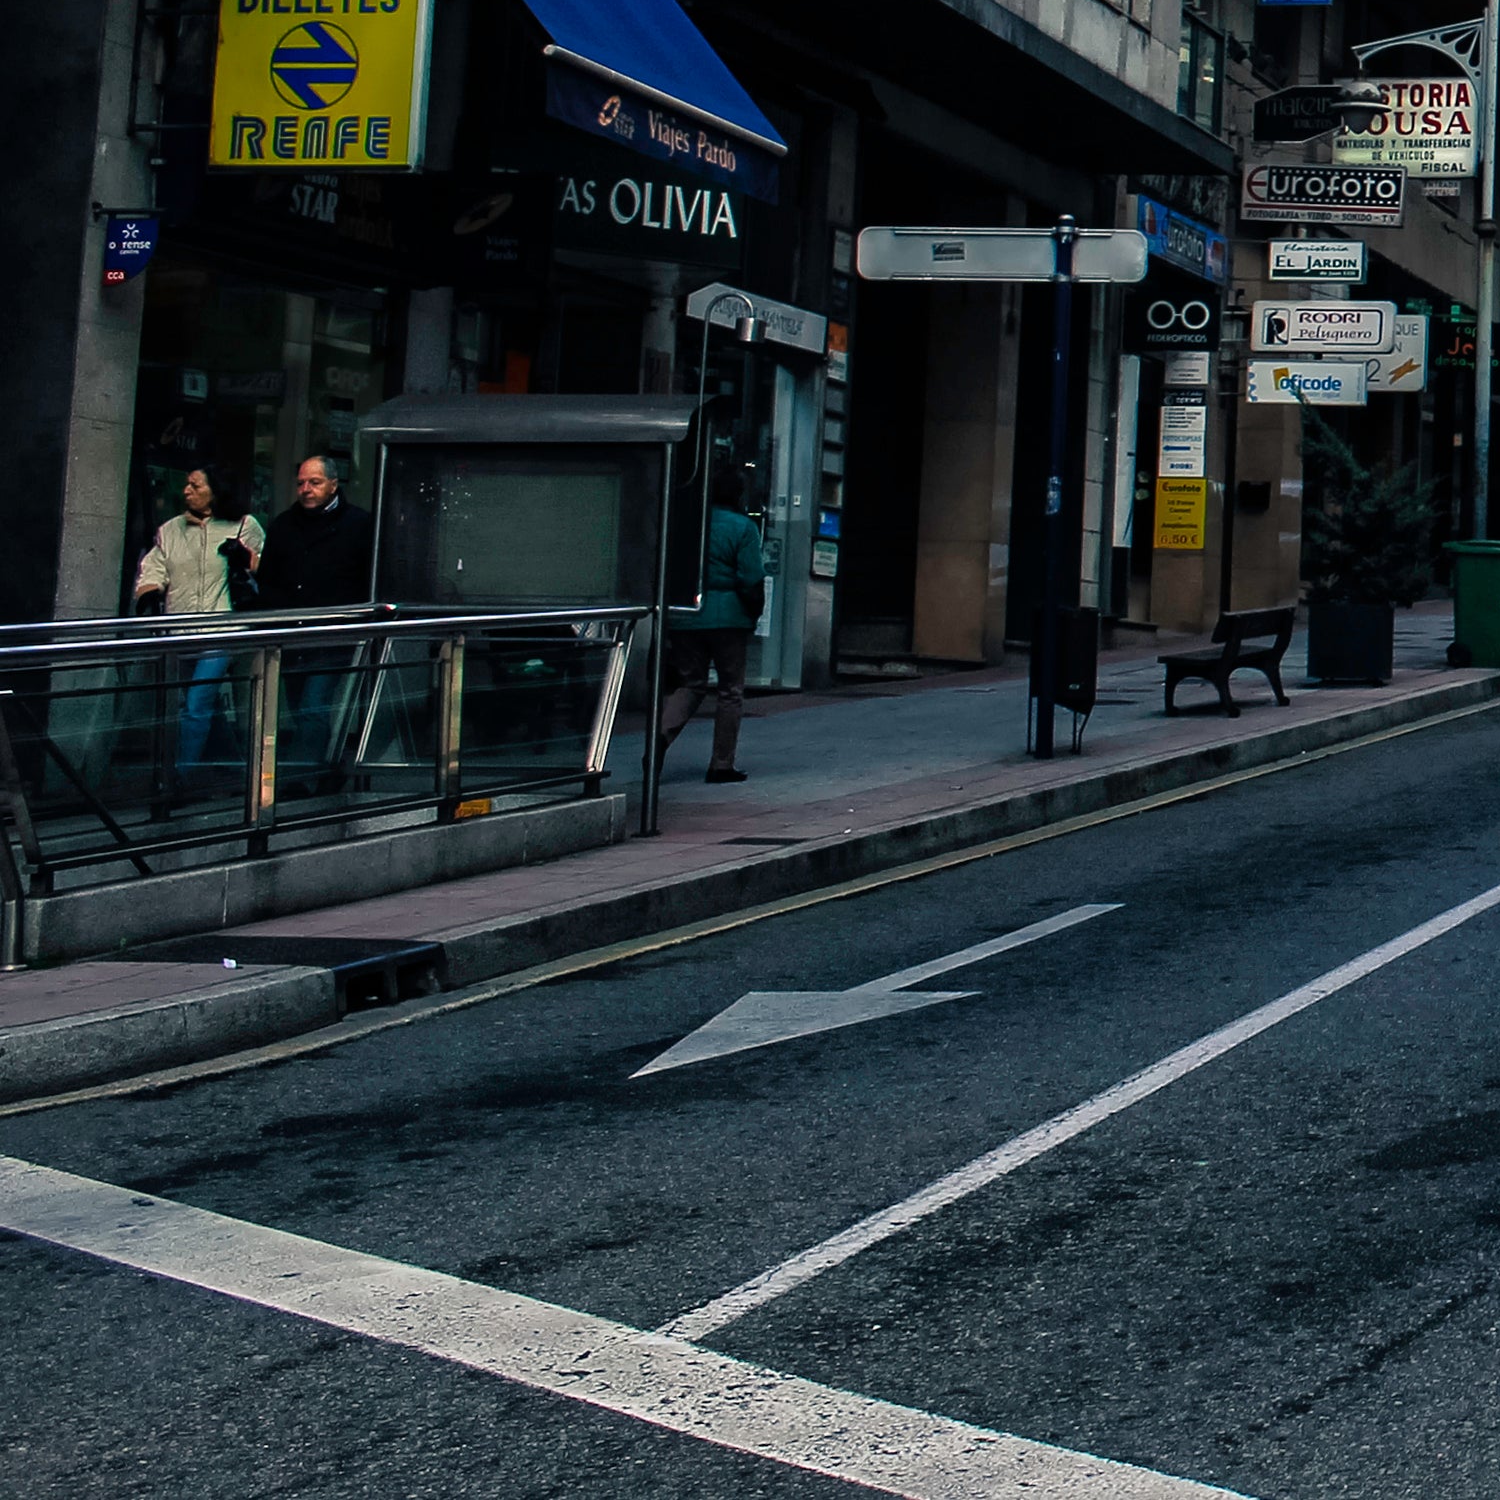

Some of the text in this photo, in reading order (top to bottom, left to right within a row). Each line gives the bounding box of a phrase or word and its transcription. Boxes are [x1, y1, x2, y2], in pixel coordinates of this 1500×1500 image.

[1377, 84, 1471, 107] STORIA
[1346, 111, 1472, 135] OUSA
[229, 115, 391, 160] RENFE
[648, 110, 737, 173] Viajes Pardo
[1336, 139, 1471, 149] MATRICULAS Y TRANSFERENCIAS
[1372, 151, 1435, 160] DE VEHICULOS
[1422, 163, 1467, 173] FISCAL
[290, 182, 341, 224] STAR
[558, 178, 737, 238] AS OLIVIA
[1248, 210, 1300, 219] FOTOGRAFIA
[1307, 212, 1333, 220] VIDEO
[1342, 213, 1372, 222] SONIDO
[1276, 255, 1357, 273] EL JARDIN
[107, 271, 125, 281] cca
[1299, 313, 1361, 324] RODRI
[1300, 325, 1372, 342] Peluquero
[1281, 375, 1341, 390] oficode
